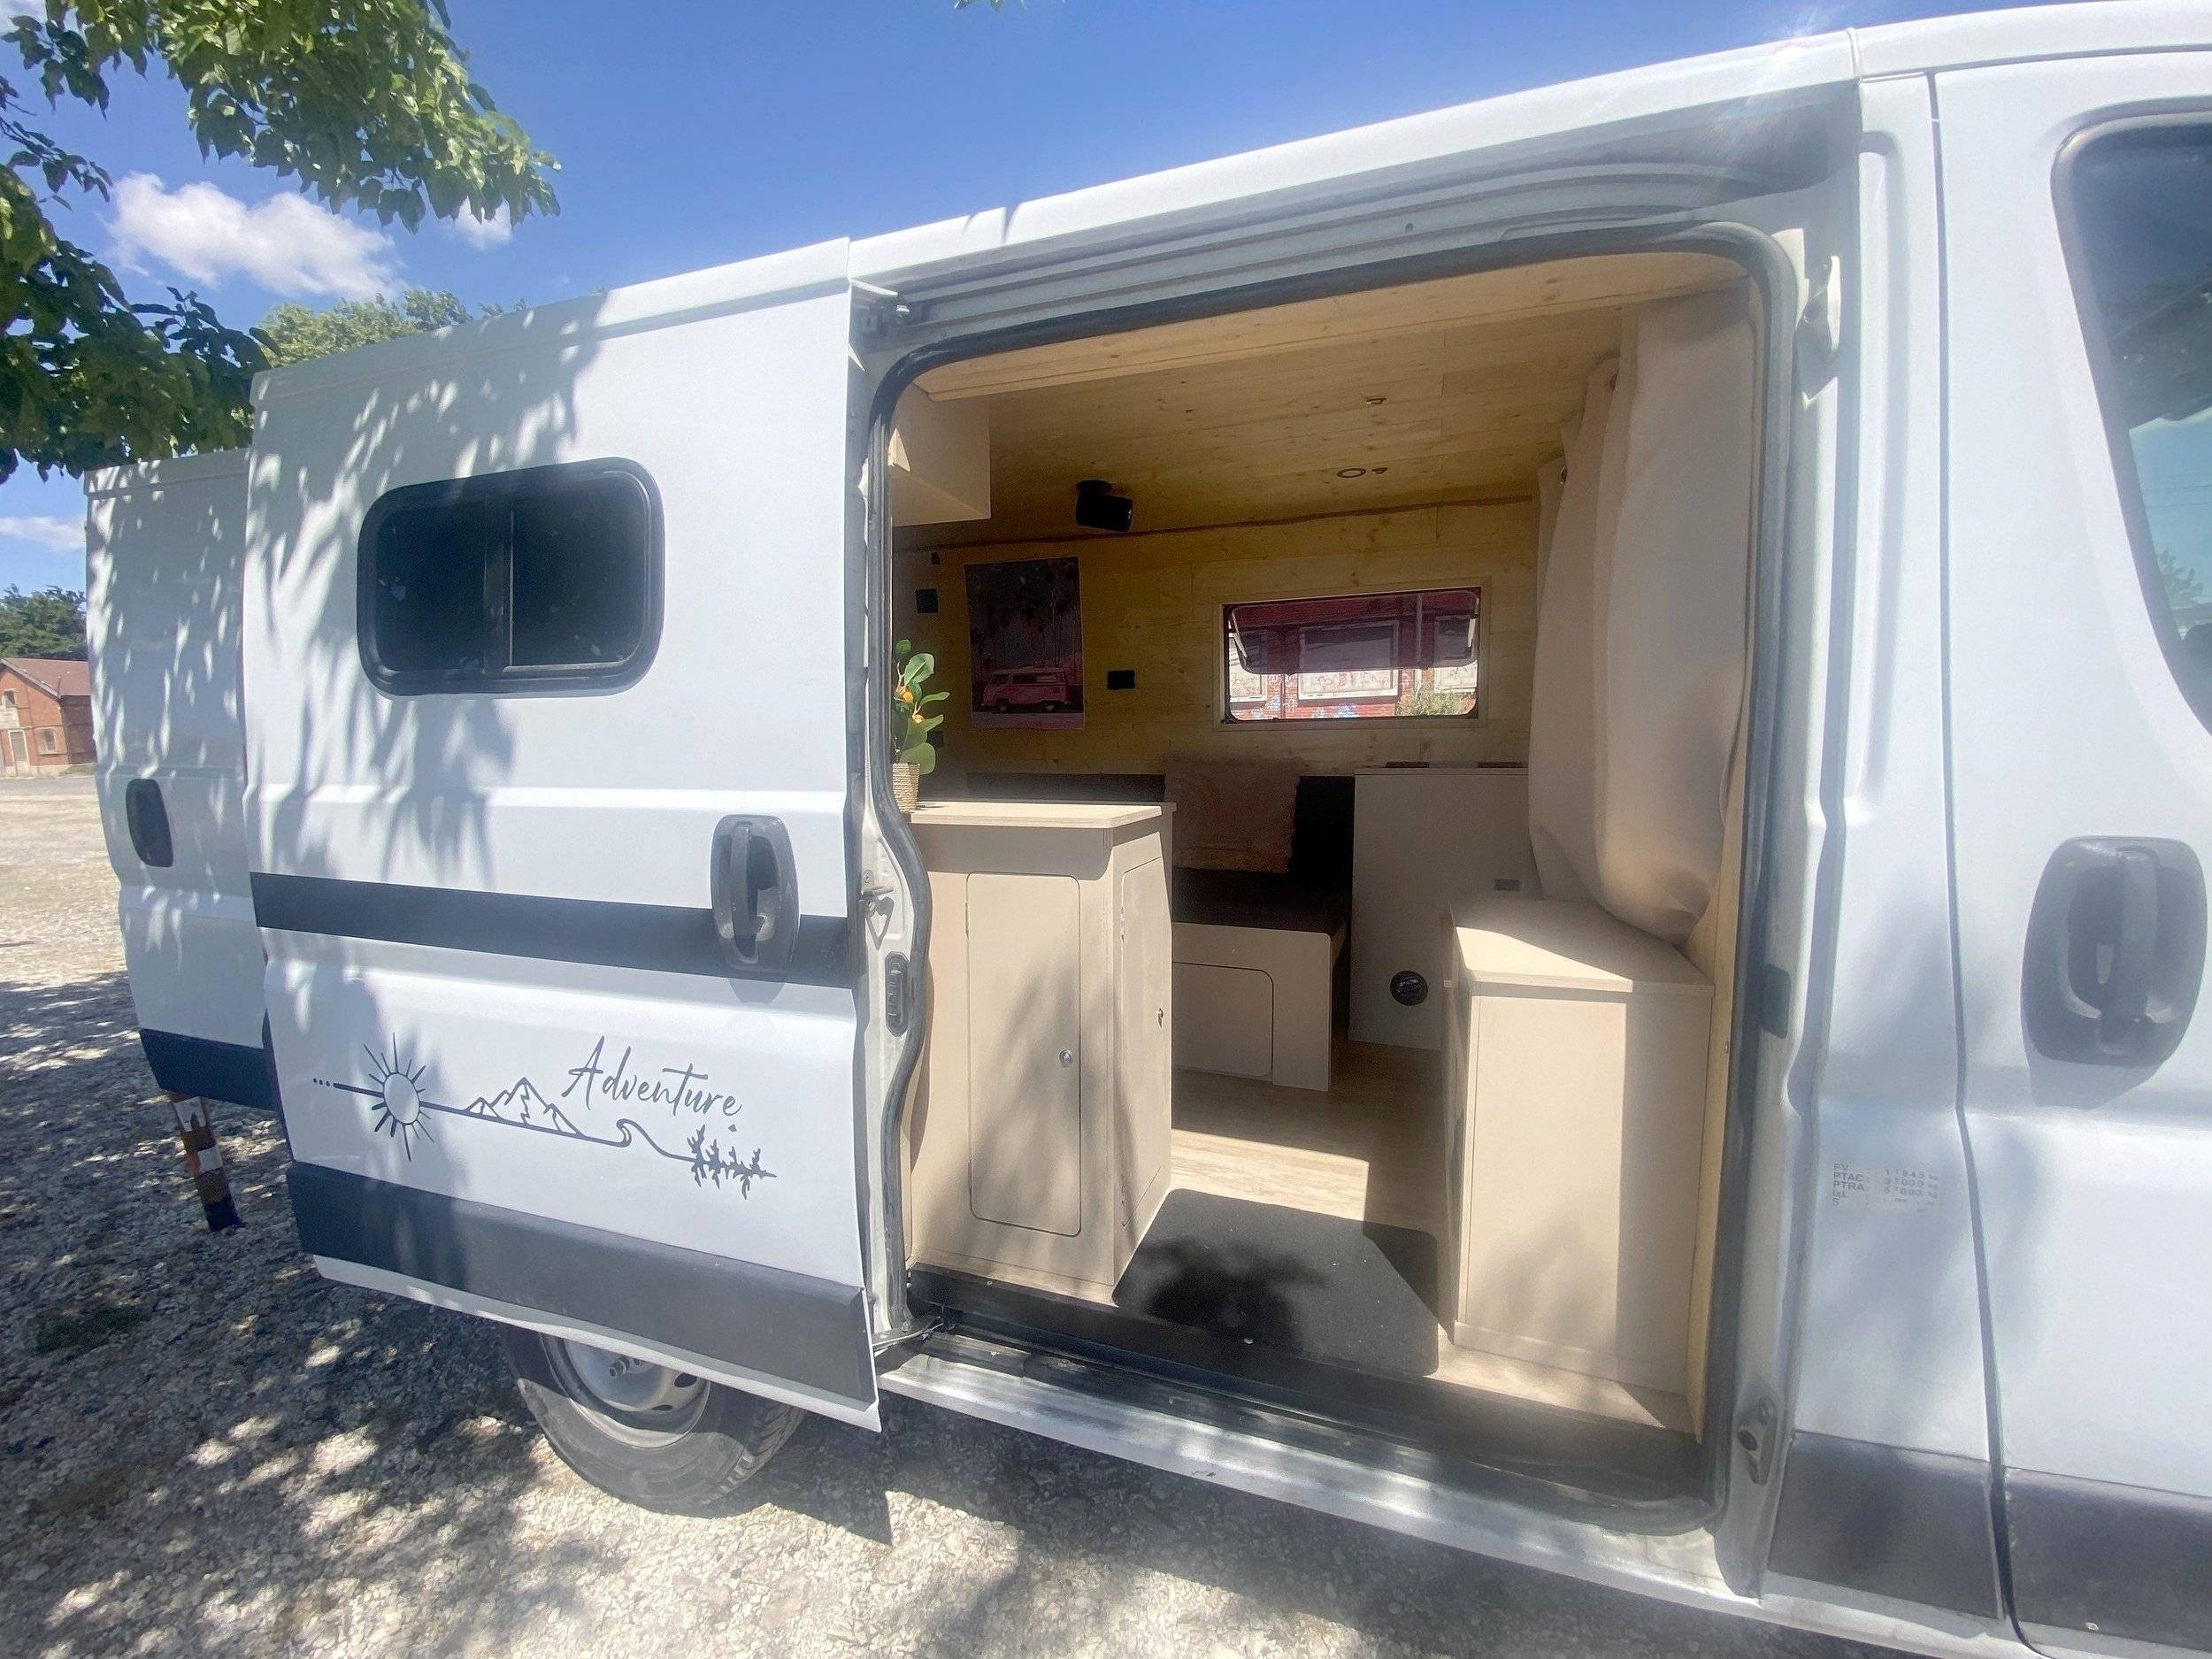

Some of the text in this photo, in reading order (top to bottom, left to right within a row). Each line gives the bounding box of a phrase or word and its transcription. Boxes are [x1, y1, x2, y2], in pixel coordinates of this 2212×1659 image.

[561, 1035, 742, 1117] Adventure
[1833, 1171, 1864, 1181] PTAC
[1832, 1180, 1864, 1191] PTRA
